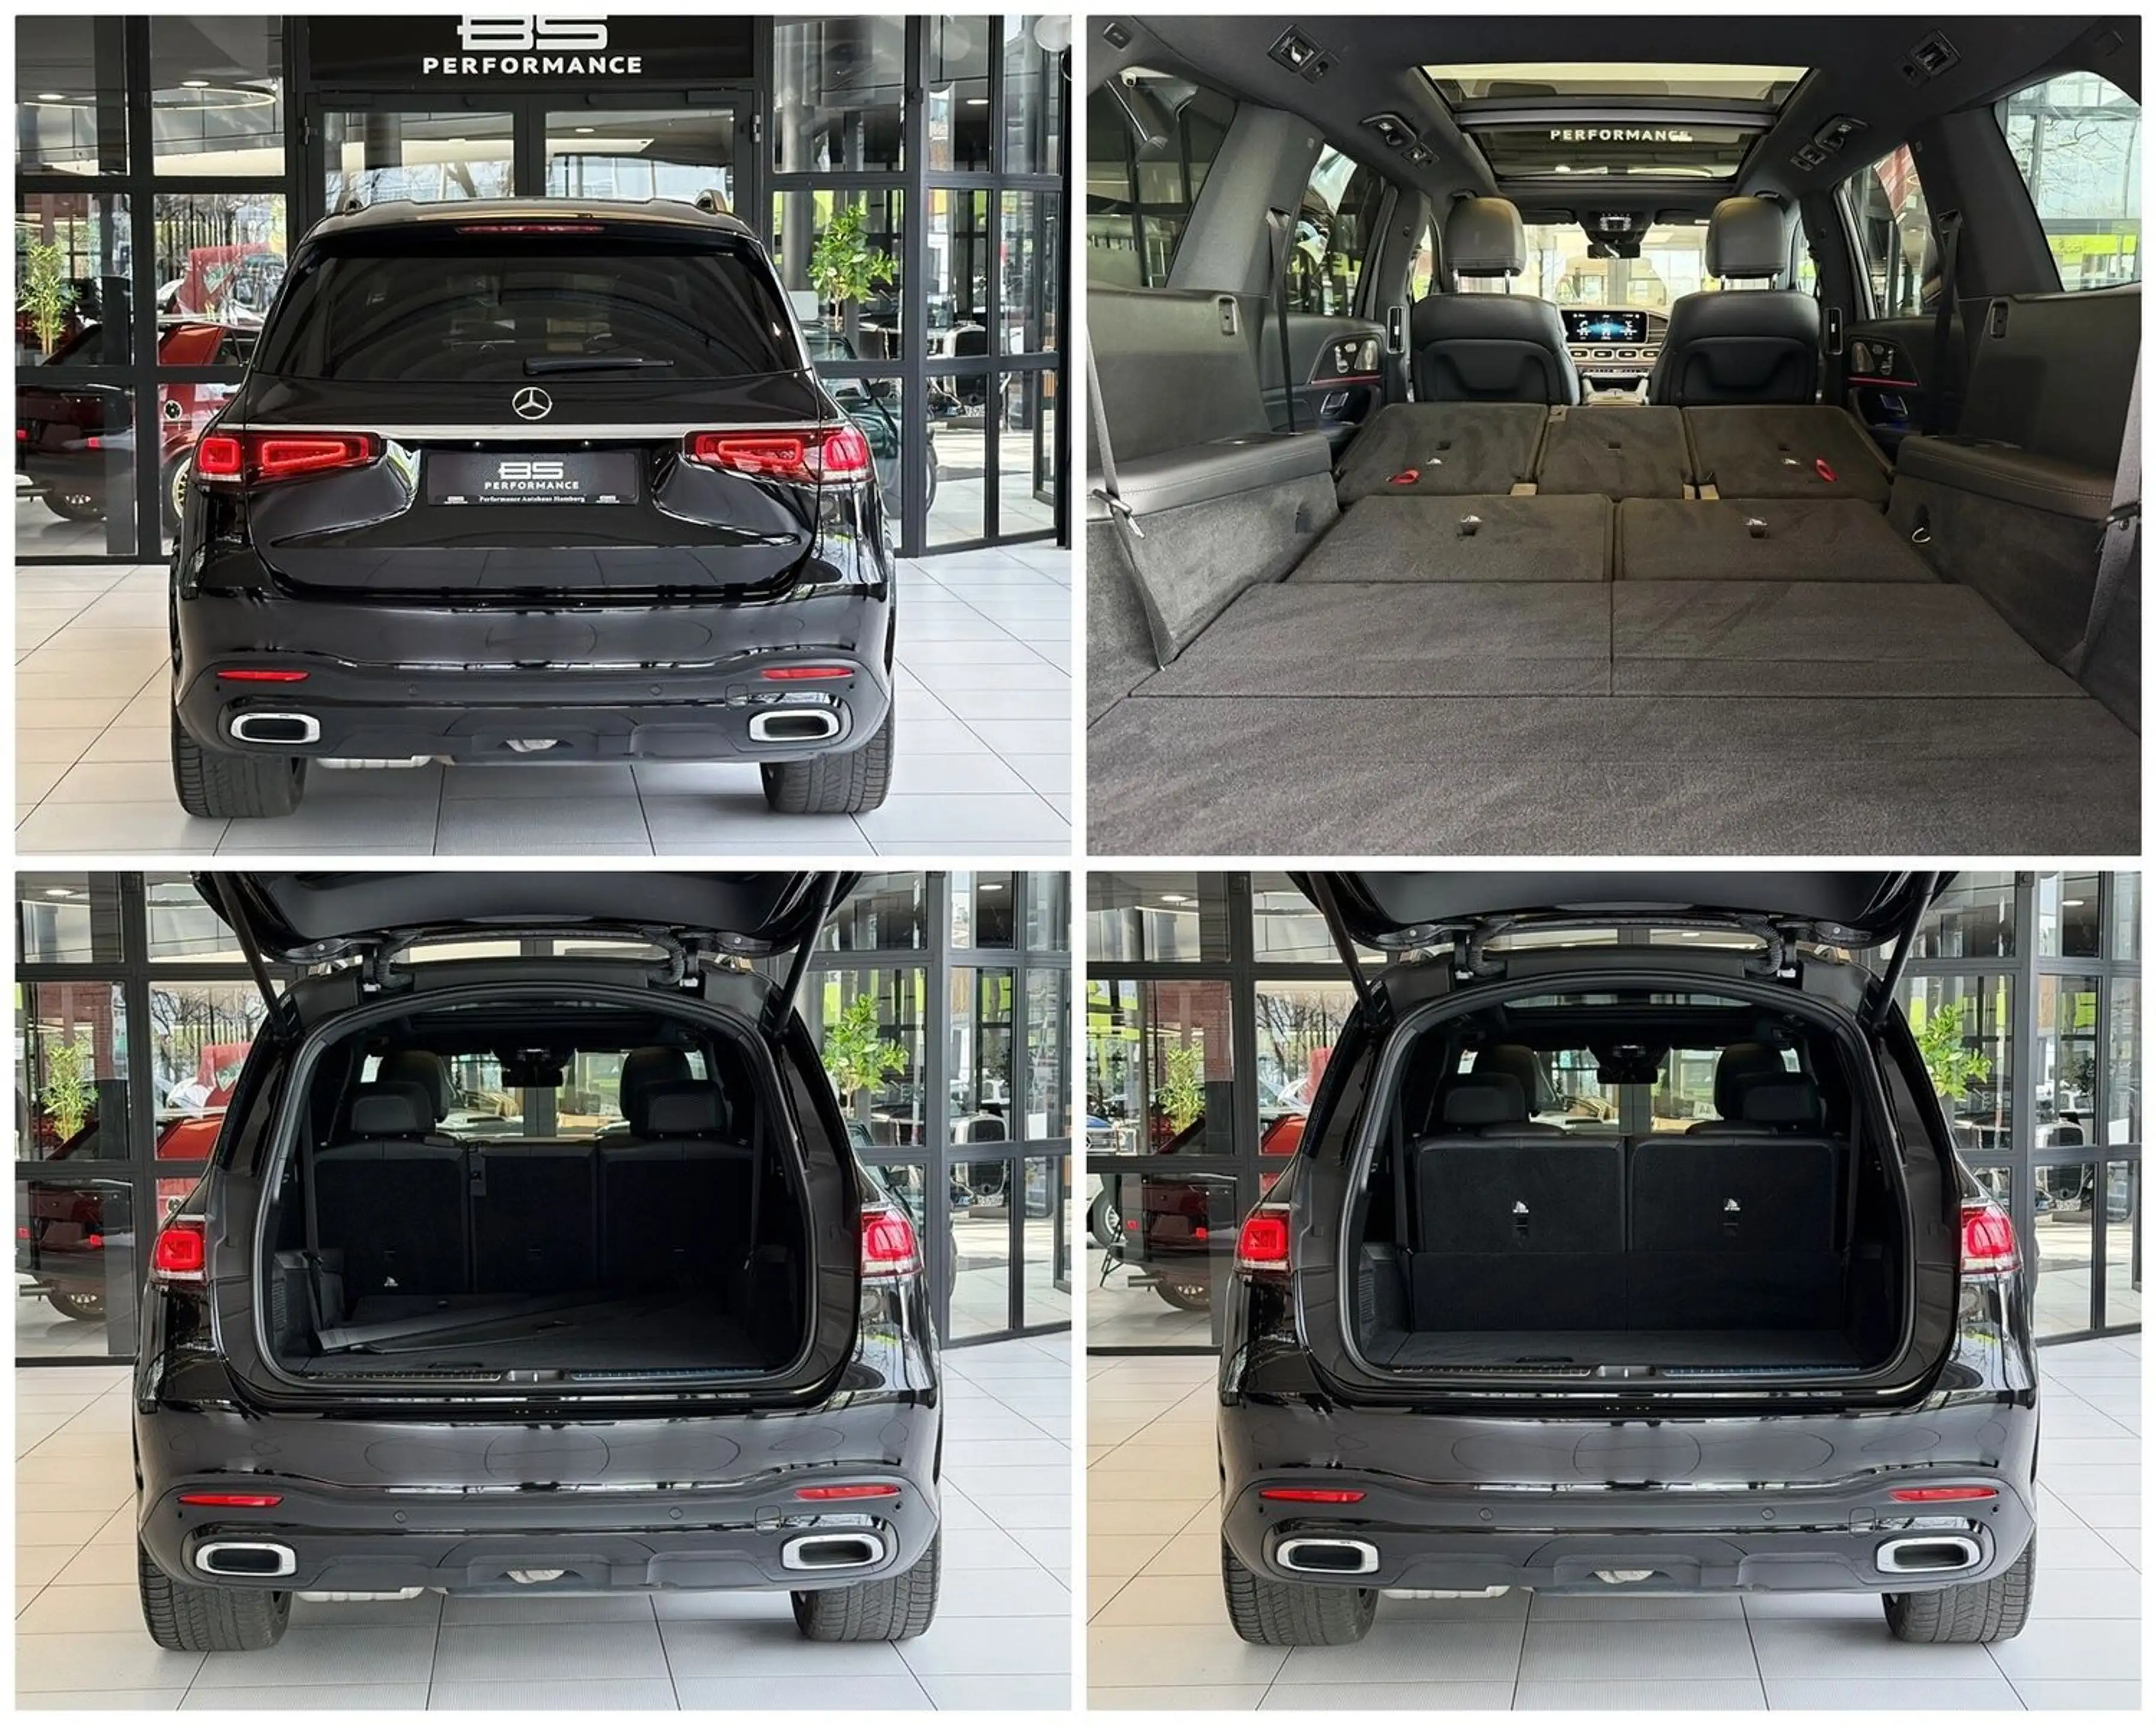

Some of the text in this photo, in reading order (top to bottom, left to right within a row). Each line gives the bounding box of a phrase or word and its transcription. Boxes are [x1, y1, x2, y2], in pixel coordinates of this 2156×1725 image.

[457, 15, 608, 50] BS
[423, 57, 641, 74] PERFORMANCE
[498, 462, 564, 480] BS
